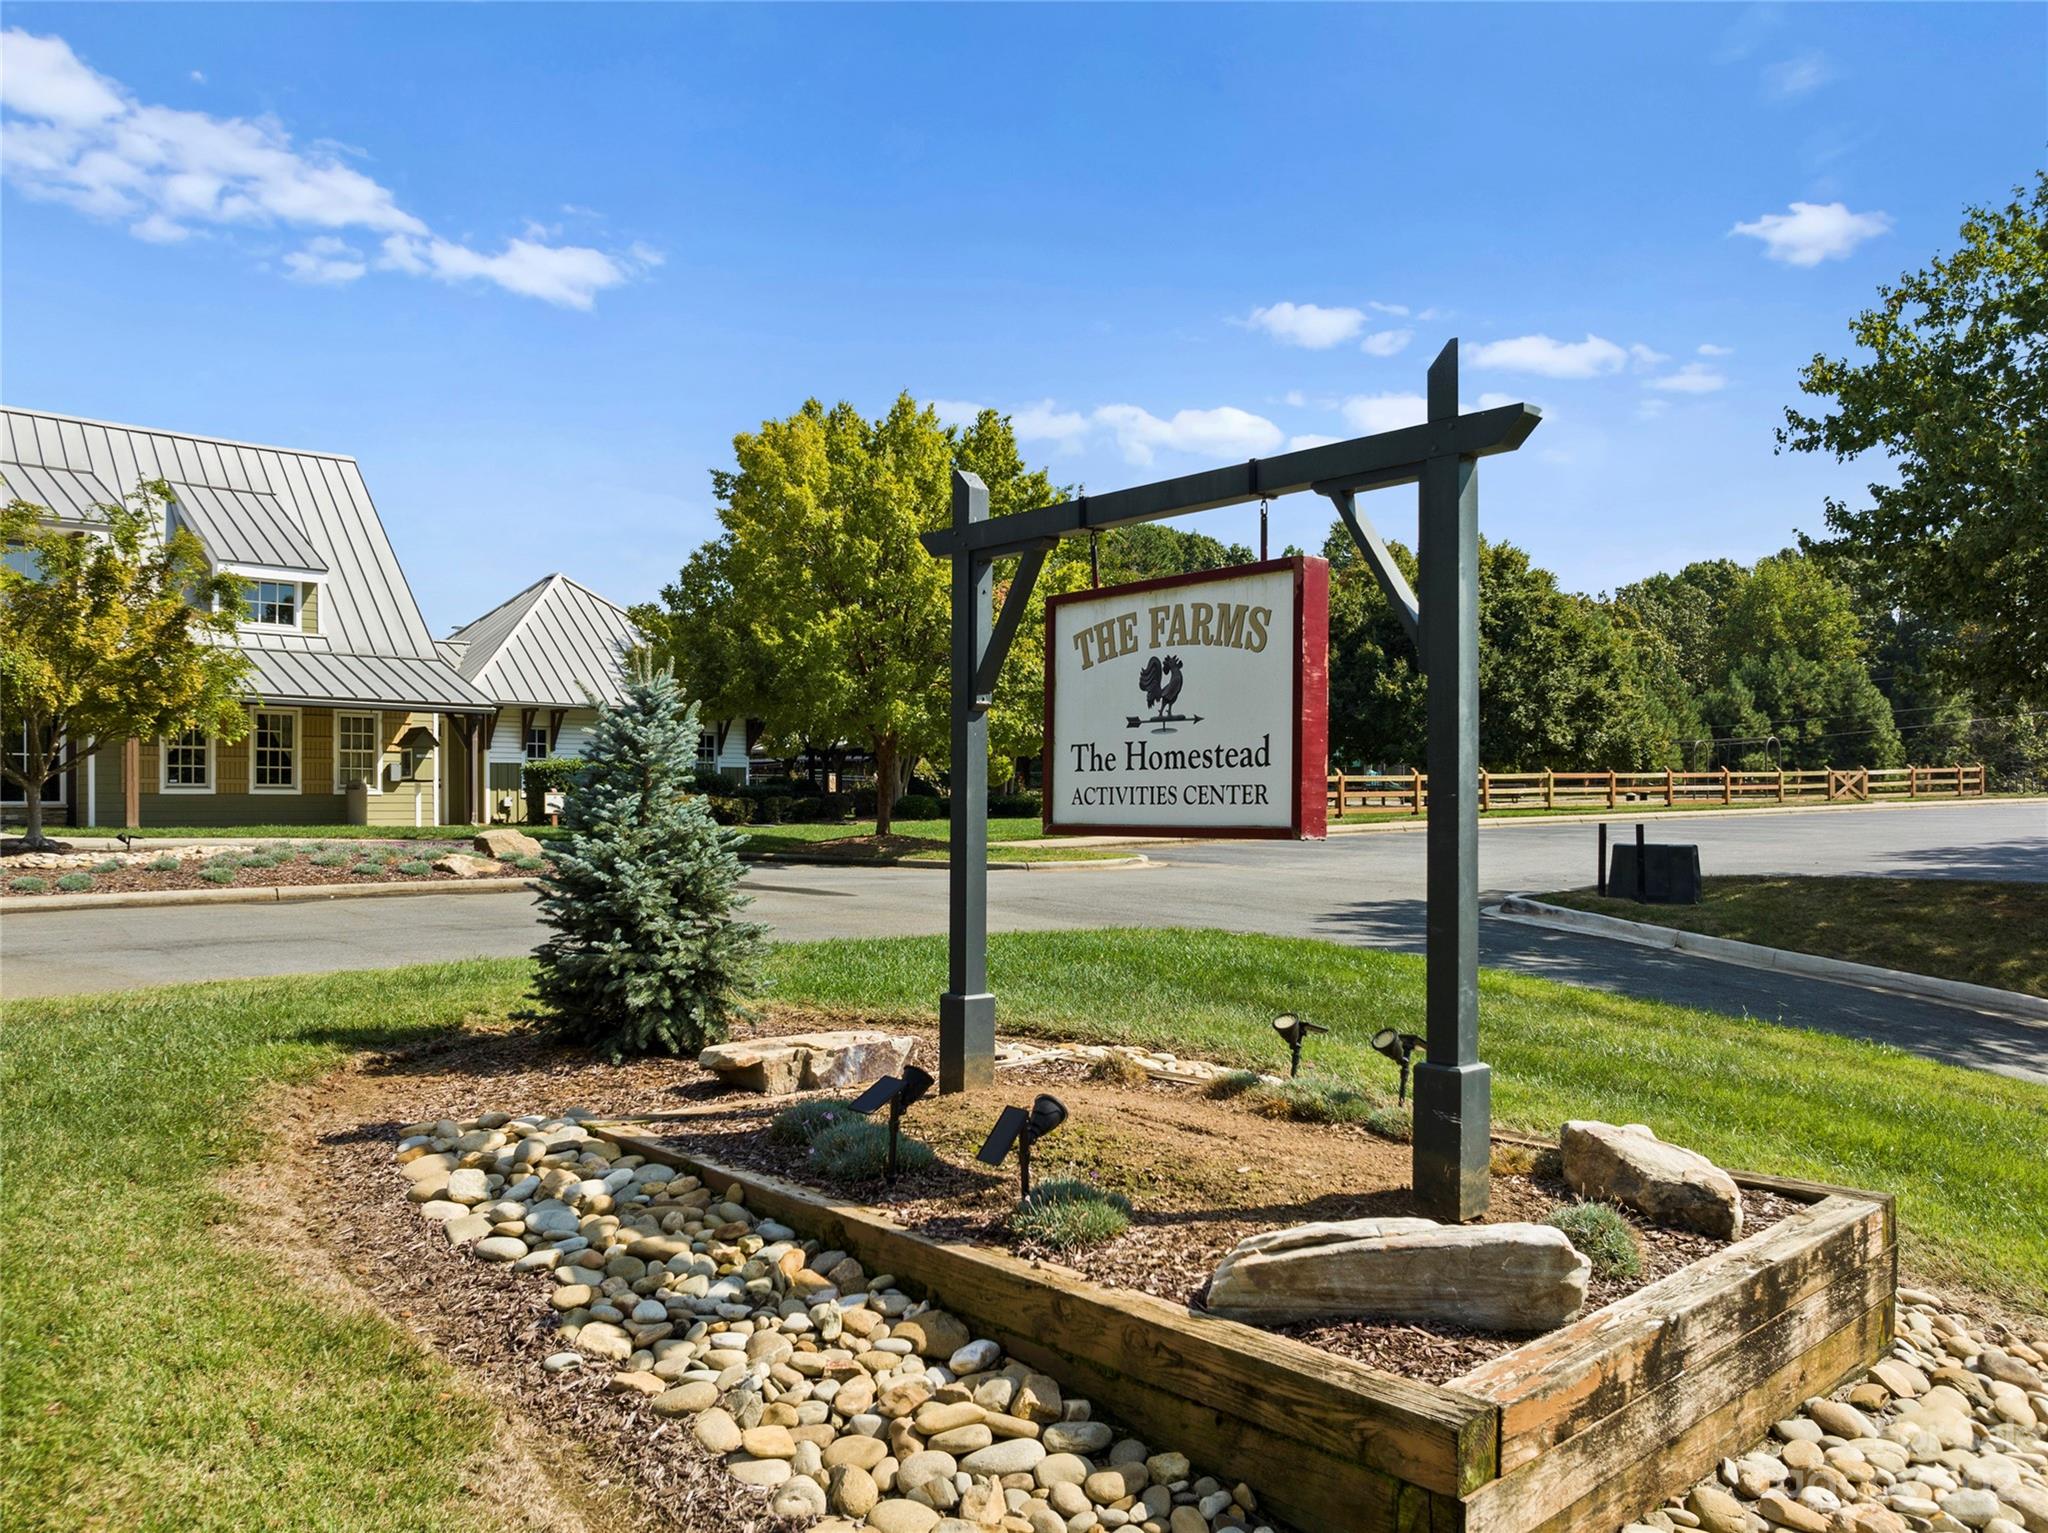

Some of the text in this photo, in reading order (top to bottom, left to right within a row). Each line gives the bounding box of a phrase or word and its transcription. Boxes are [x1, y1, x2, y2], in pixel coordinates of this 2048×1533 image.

[1073, 603, 1272, 670] THE FARMS
[1070, 734, 1271, 772] The Homestead
[1072, 784, 1269, 806] ACTIVITIES CENTER
